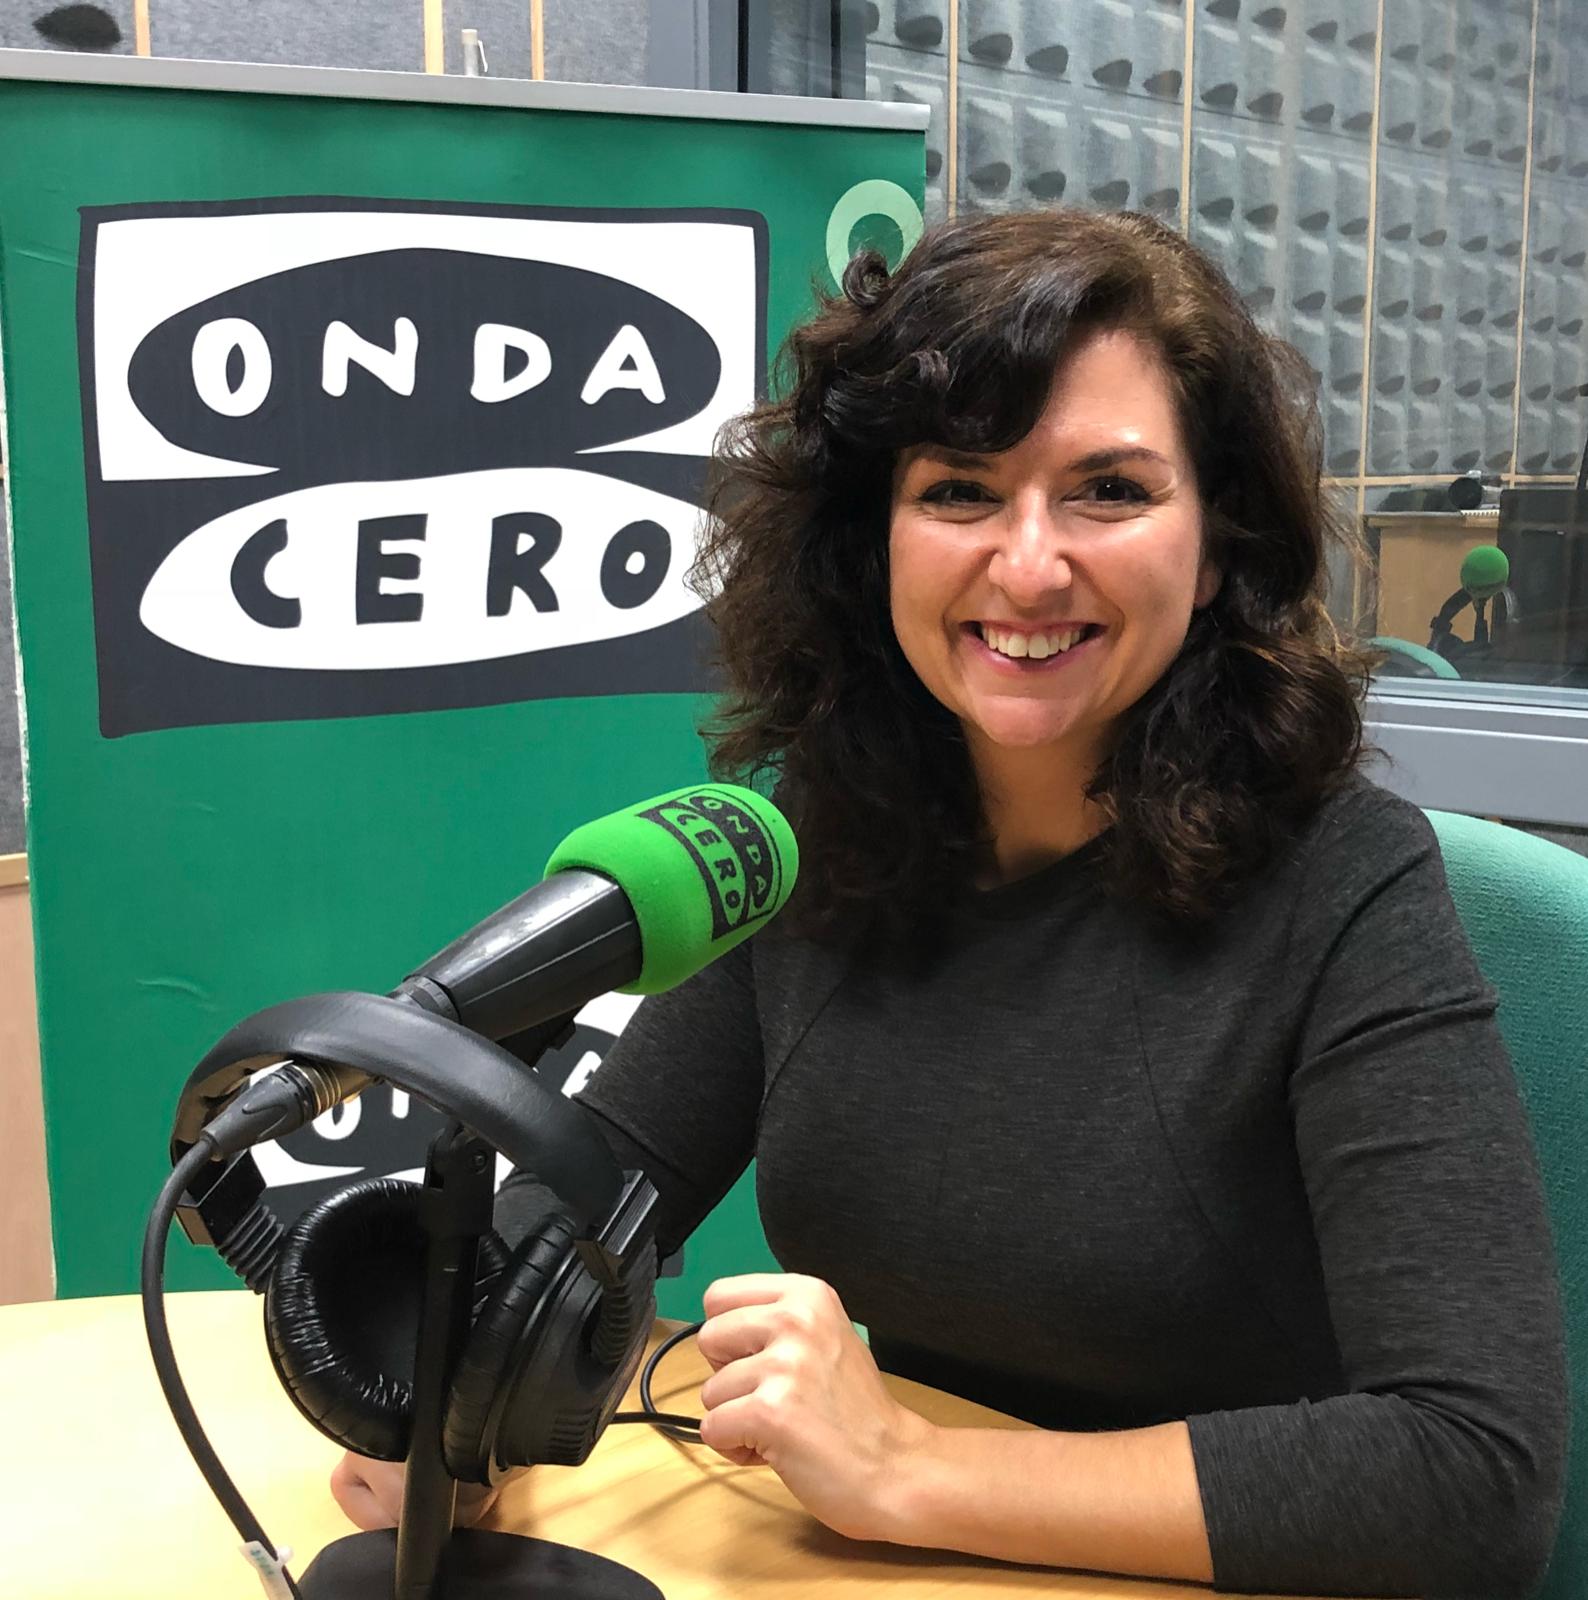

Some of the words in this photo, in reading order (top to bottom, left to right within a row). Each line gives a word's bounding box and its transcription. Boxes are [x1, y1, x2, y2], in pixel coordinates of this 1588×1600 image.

[192, 317, 666, 417] ONDA
[230, 511, 671, 628] CERO
[677, 814, 741, 908] CERO
[703, 799, 767, 894] ONDA
